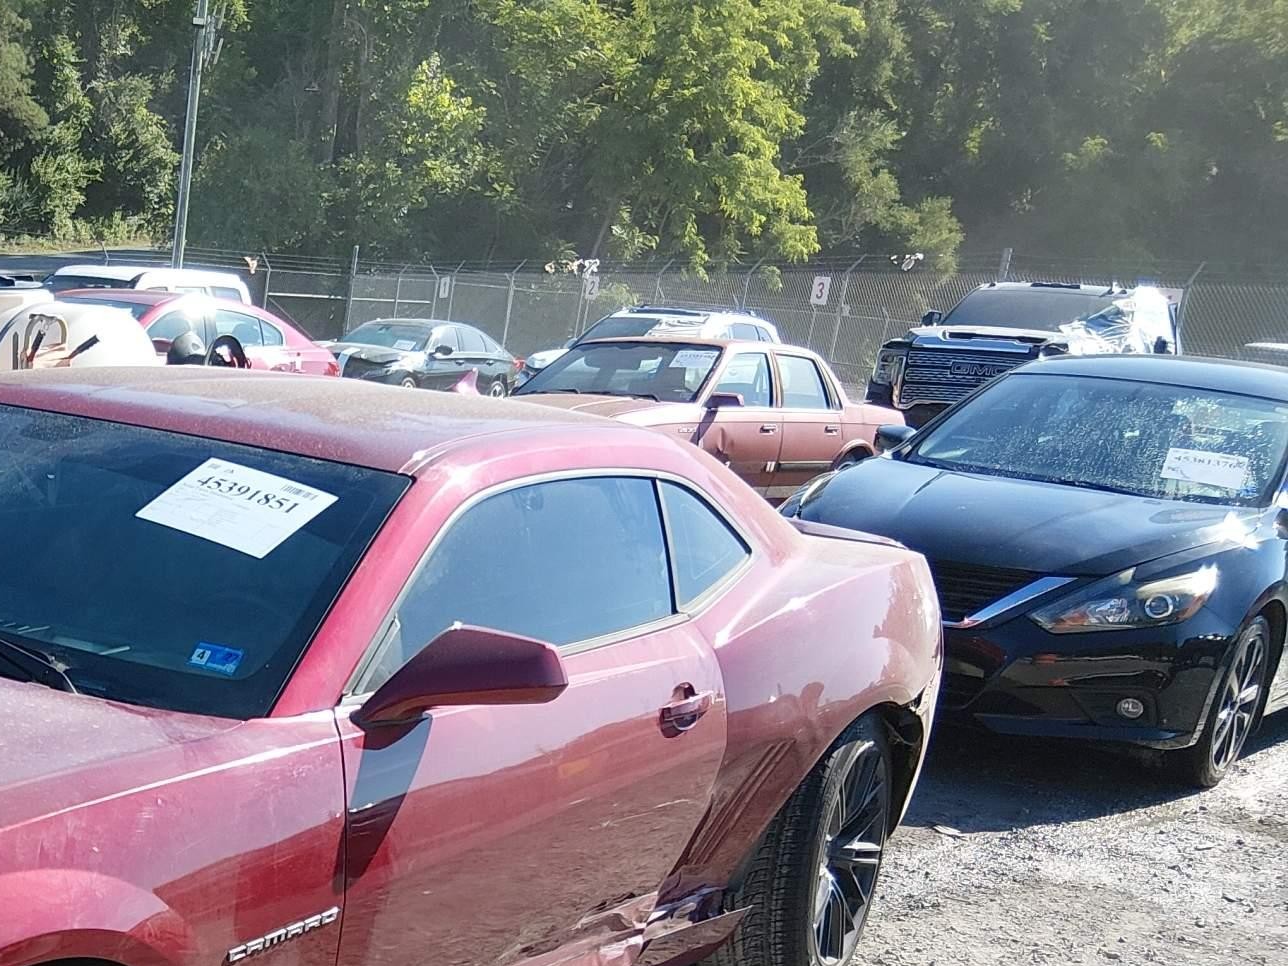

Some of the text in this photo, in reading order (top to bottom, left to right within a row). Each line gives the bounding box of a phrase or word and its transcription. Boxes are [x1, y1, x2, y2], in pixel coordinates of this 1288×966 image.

[588, 279, 595, 295] 2
[815, 281, 825, 299] 3
[197, 475, 301, 514] 45391851
[197, 650, 206, 660] 4
